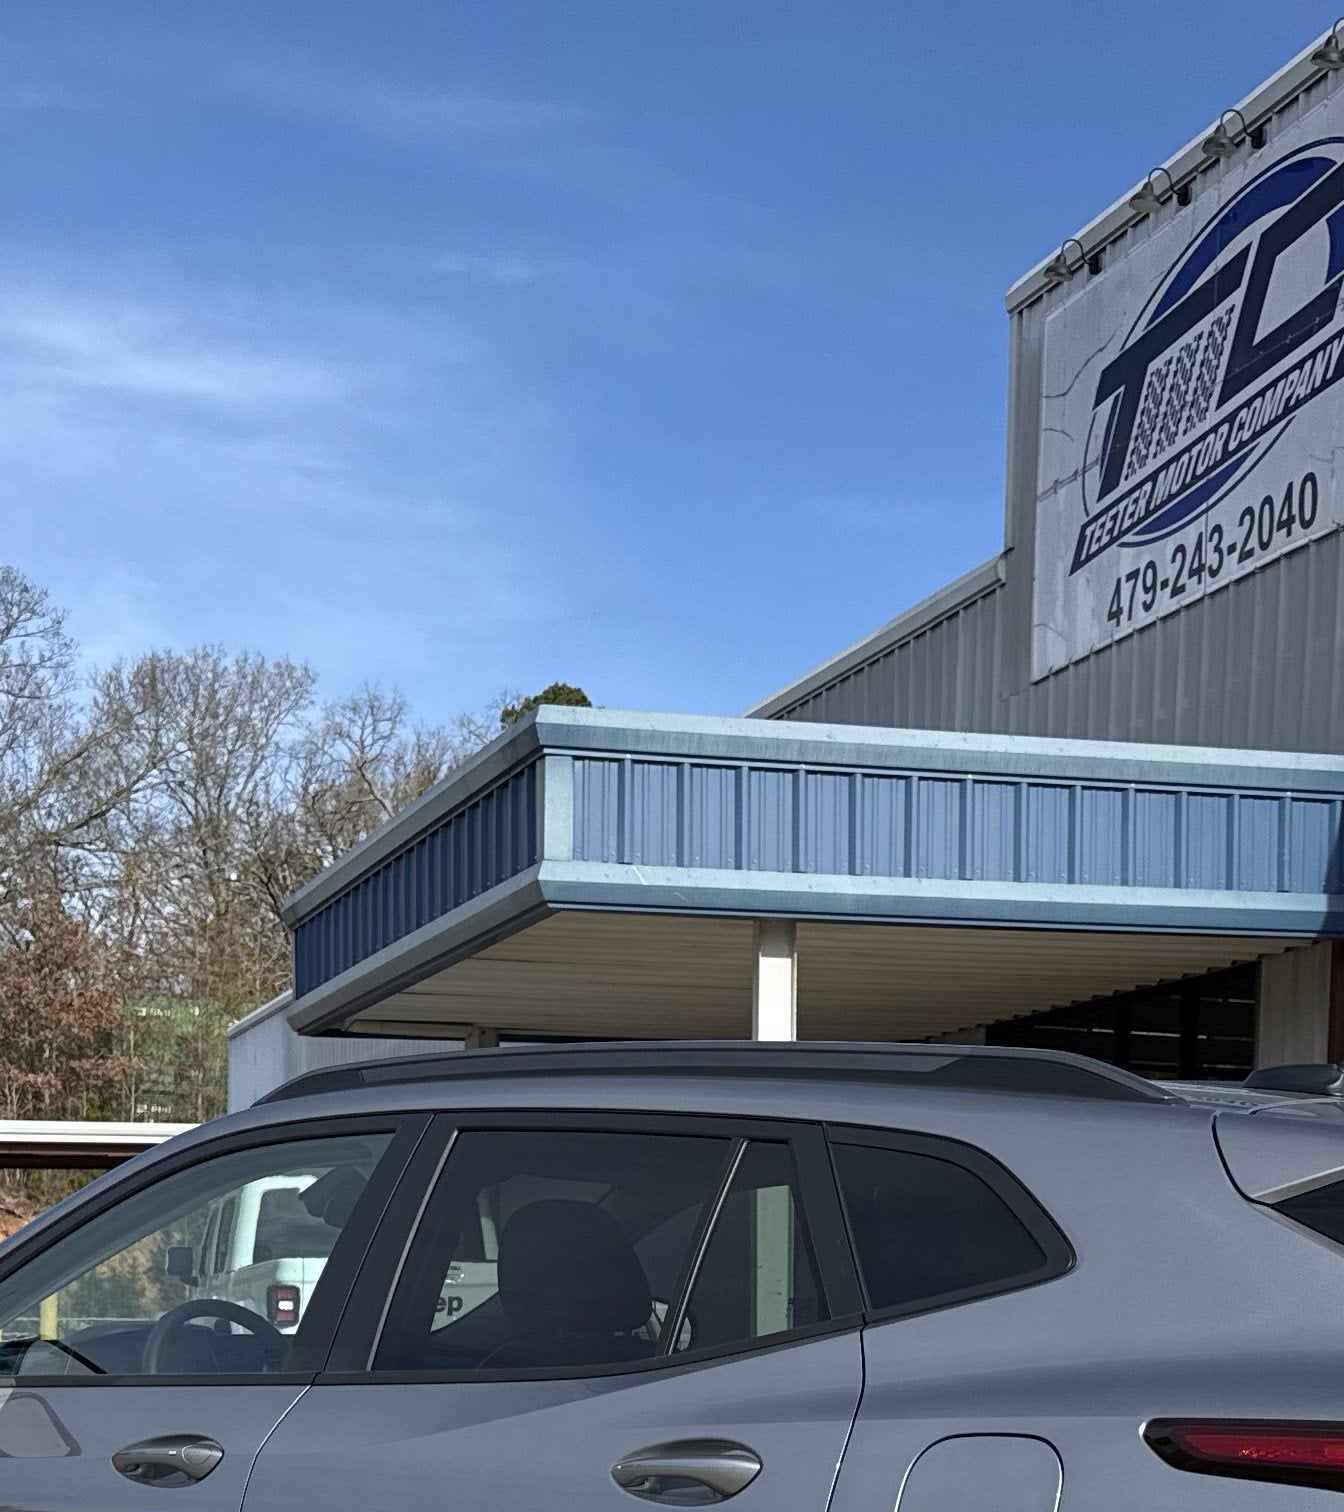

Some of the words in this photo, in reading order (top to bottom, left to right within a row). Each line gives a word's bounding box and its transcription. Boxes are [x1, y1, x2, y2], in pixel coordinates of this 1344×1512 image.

[1079, 477, 1154, 561] TEETER
[1153, 422, 1229, 503] MOTOR
[1107, 471, 1318, 627] 479-243-2040
